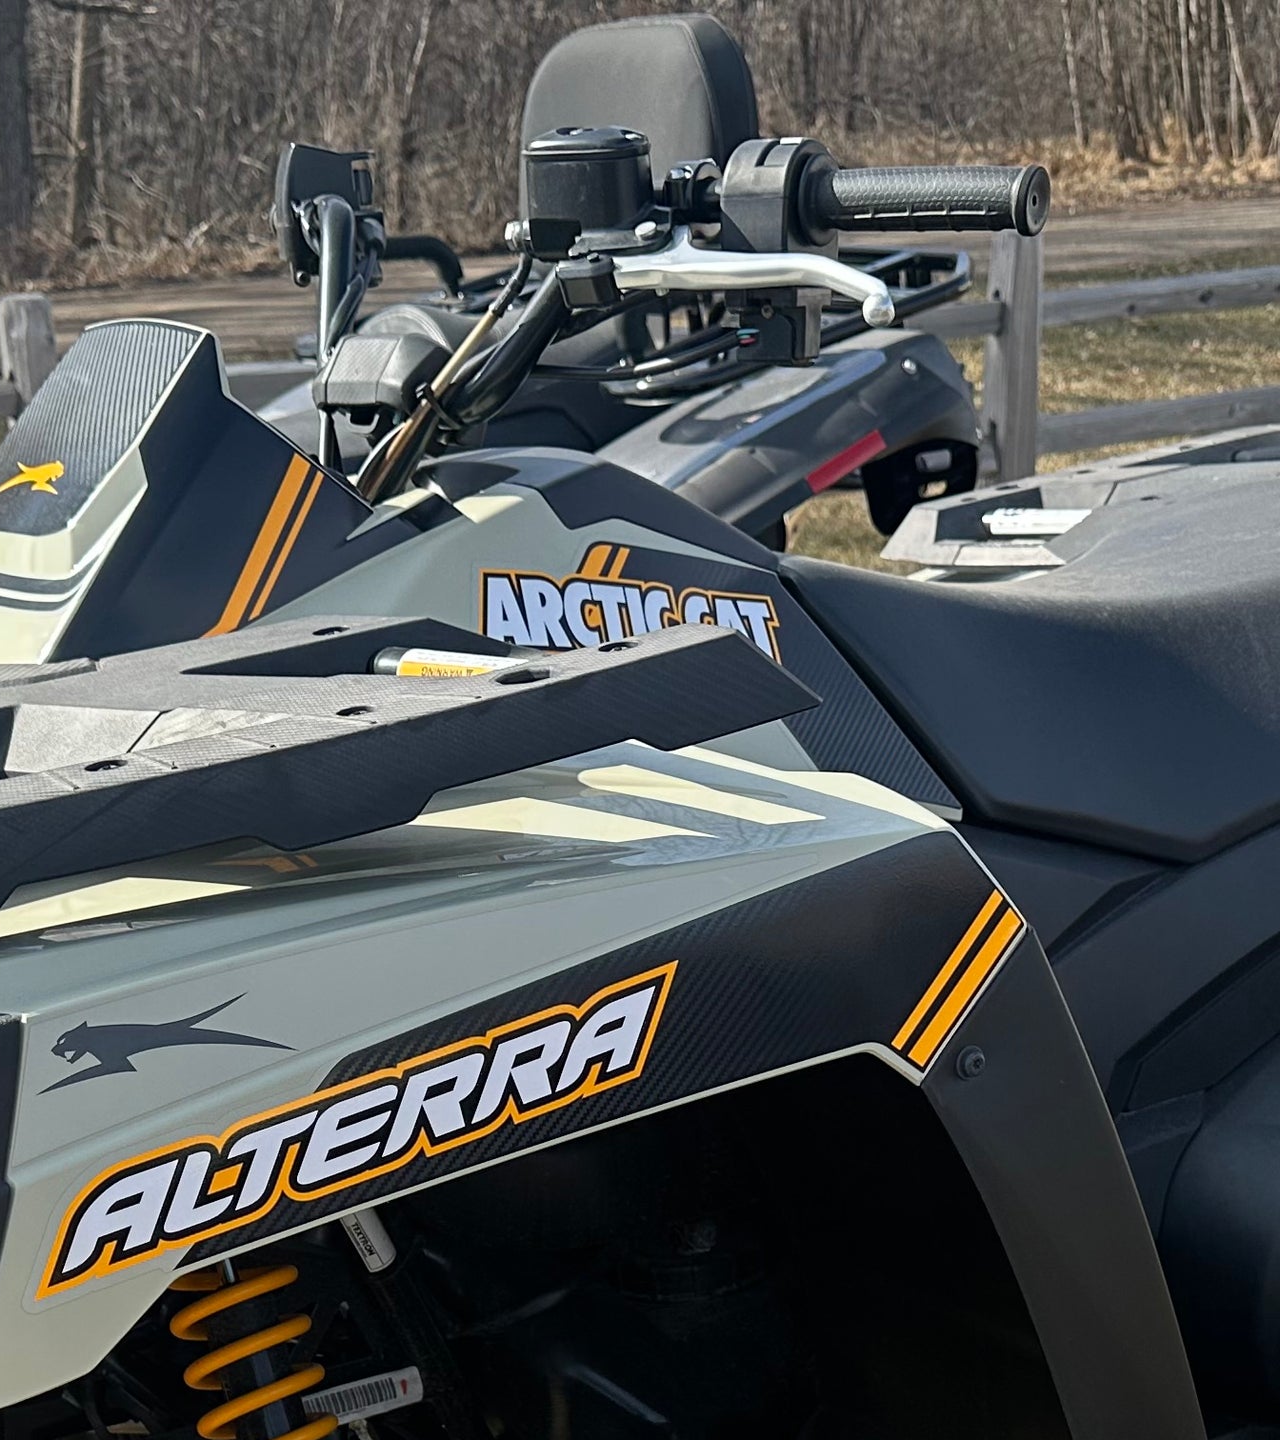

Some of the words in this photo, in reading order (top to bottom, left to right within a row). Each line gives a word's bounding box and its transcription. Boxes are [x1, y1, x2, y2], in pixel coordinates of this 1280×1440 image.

[485, 575, 672, 649] ARCTIC
[60, 984, 658, 1277] ALTERRA
[350, 1221, 376, 1257] TEXTRON
